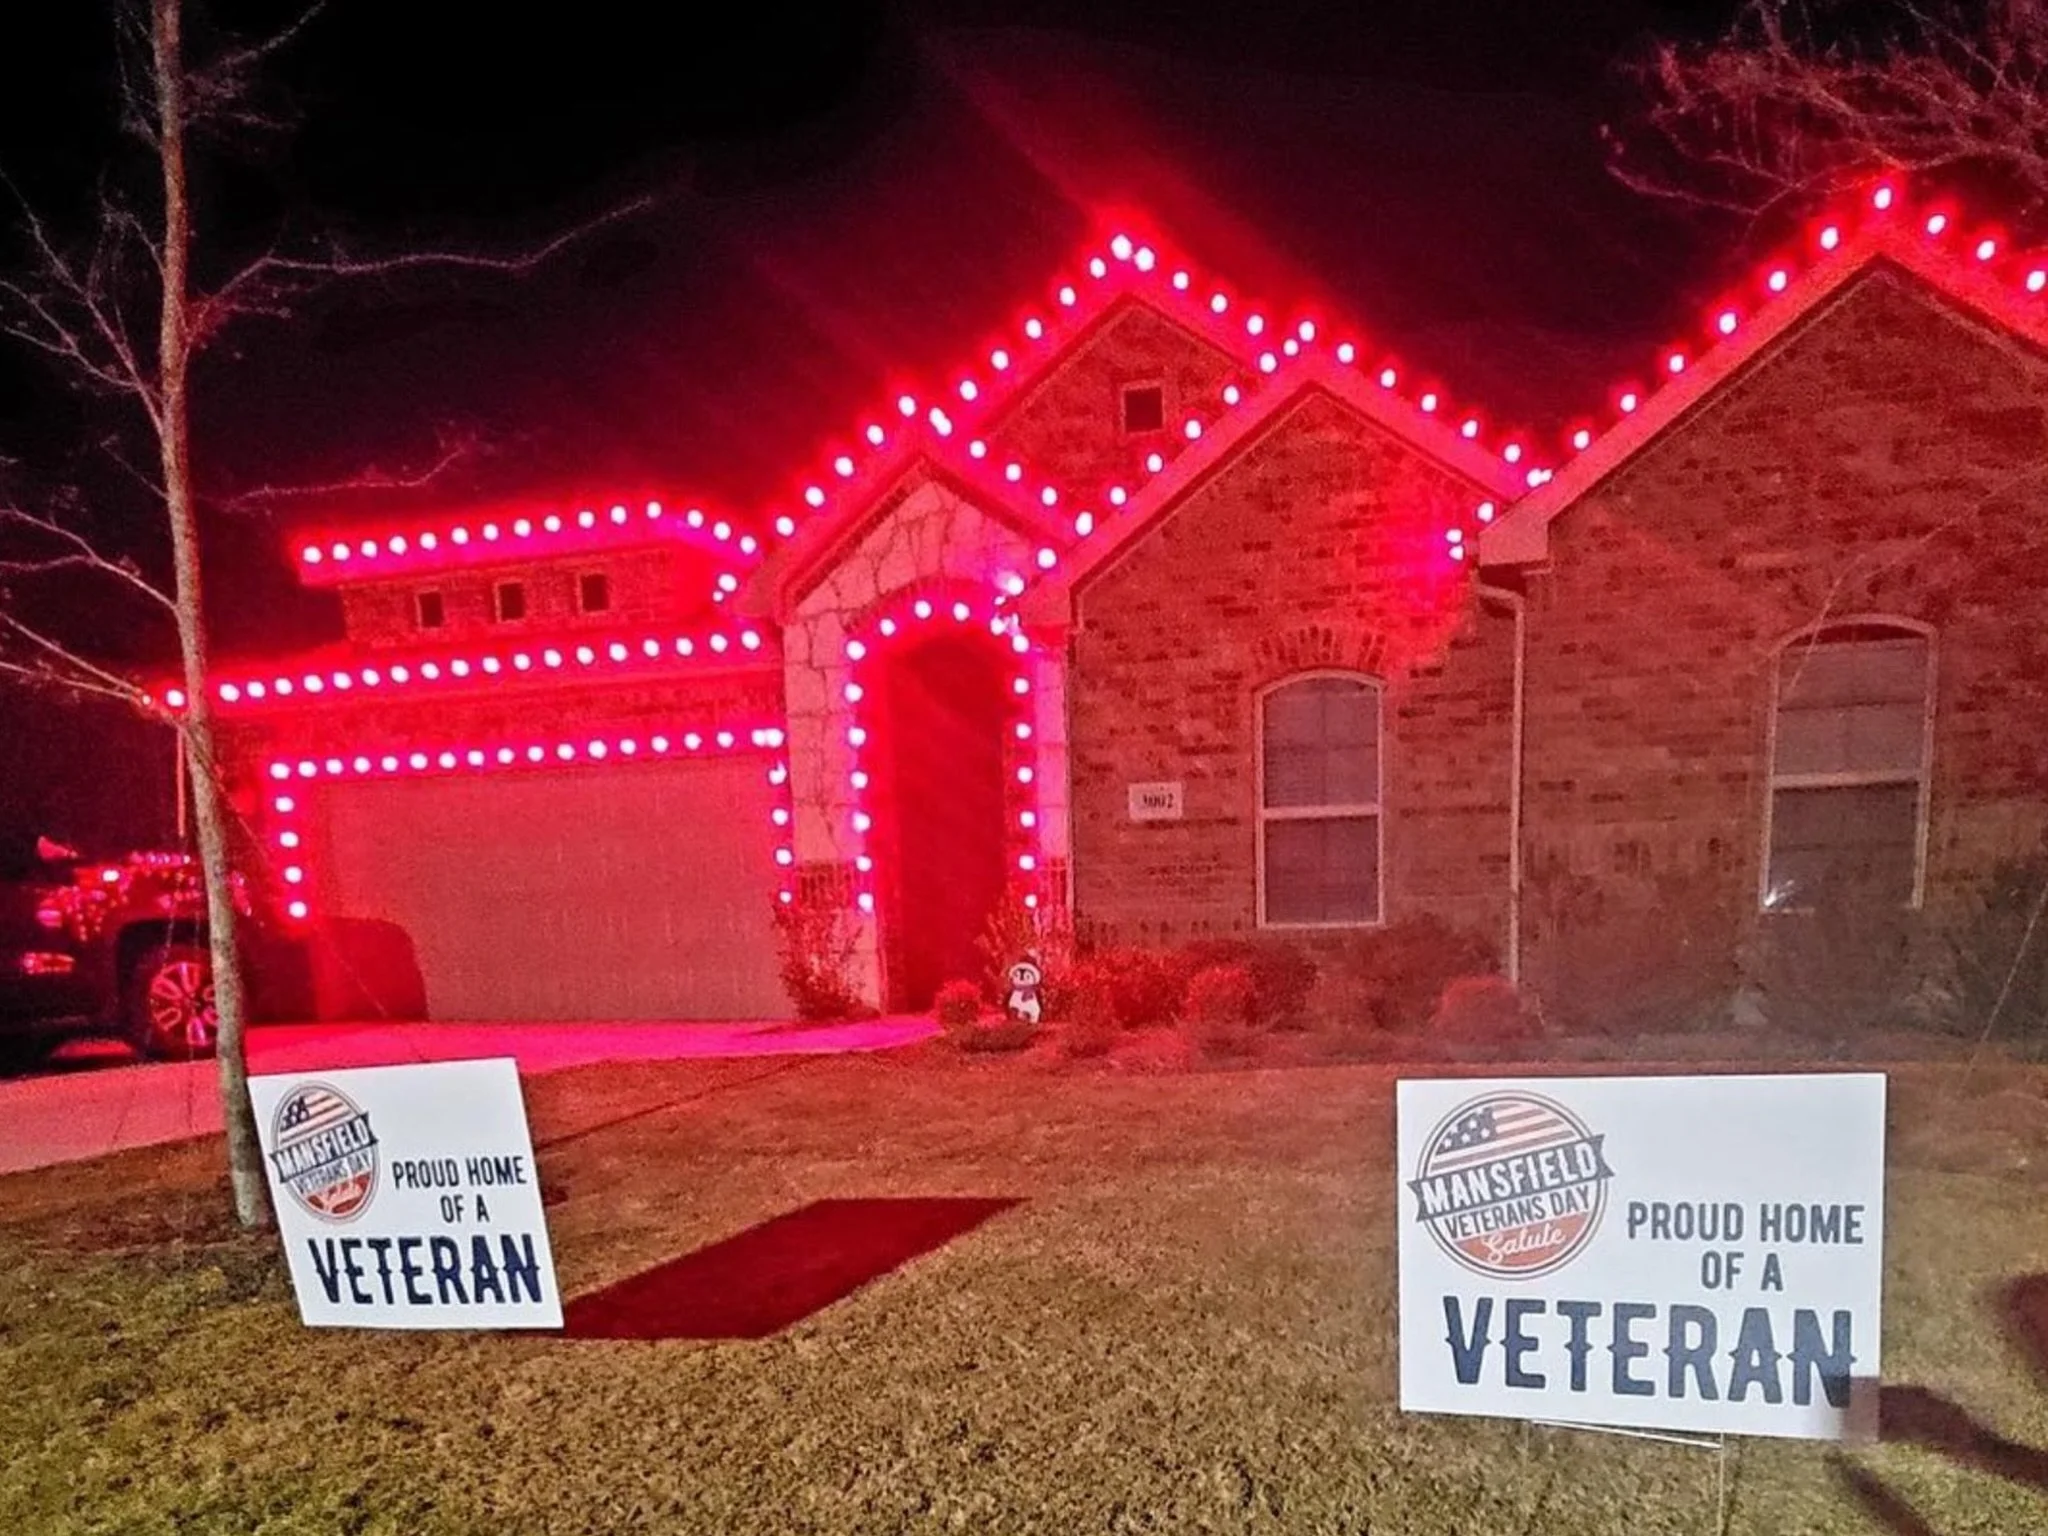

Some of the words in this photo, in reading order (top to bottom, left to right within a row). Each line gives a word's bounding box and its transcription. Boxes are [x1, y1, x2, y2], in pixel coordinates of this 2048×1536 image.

[276, 1118, 370, 1180] MANSFIELD
[392, 1158, 460, 1189] PROUD
[466, 1156, 527, 1186] HOME
[1421, 1143, 1597, 1215] MANSFIELD
[440, 1194, 464, 1223] OF
[475, 1194, 490, 1222] A
[1444, 1196, 1545, 1240] VETERANS
[1550, 1184, 1590, 1216] DAY
[1627, 1202, 1744, 1242] PROUD
[1760, 1204, 1865, 1245] HOME
[1482, 1223, 1567, 1264] Salute
[307, 1233, 543, 1305] VETERAN
[1701, 1251, 1743, 1290] OF
[1761, 1253, 1784, 1291] A
[1443, 1295, 1857, 1408] VETERAN
